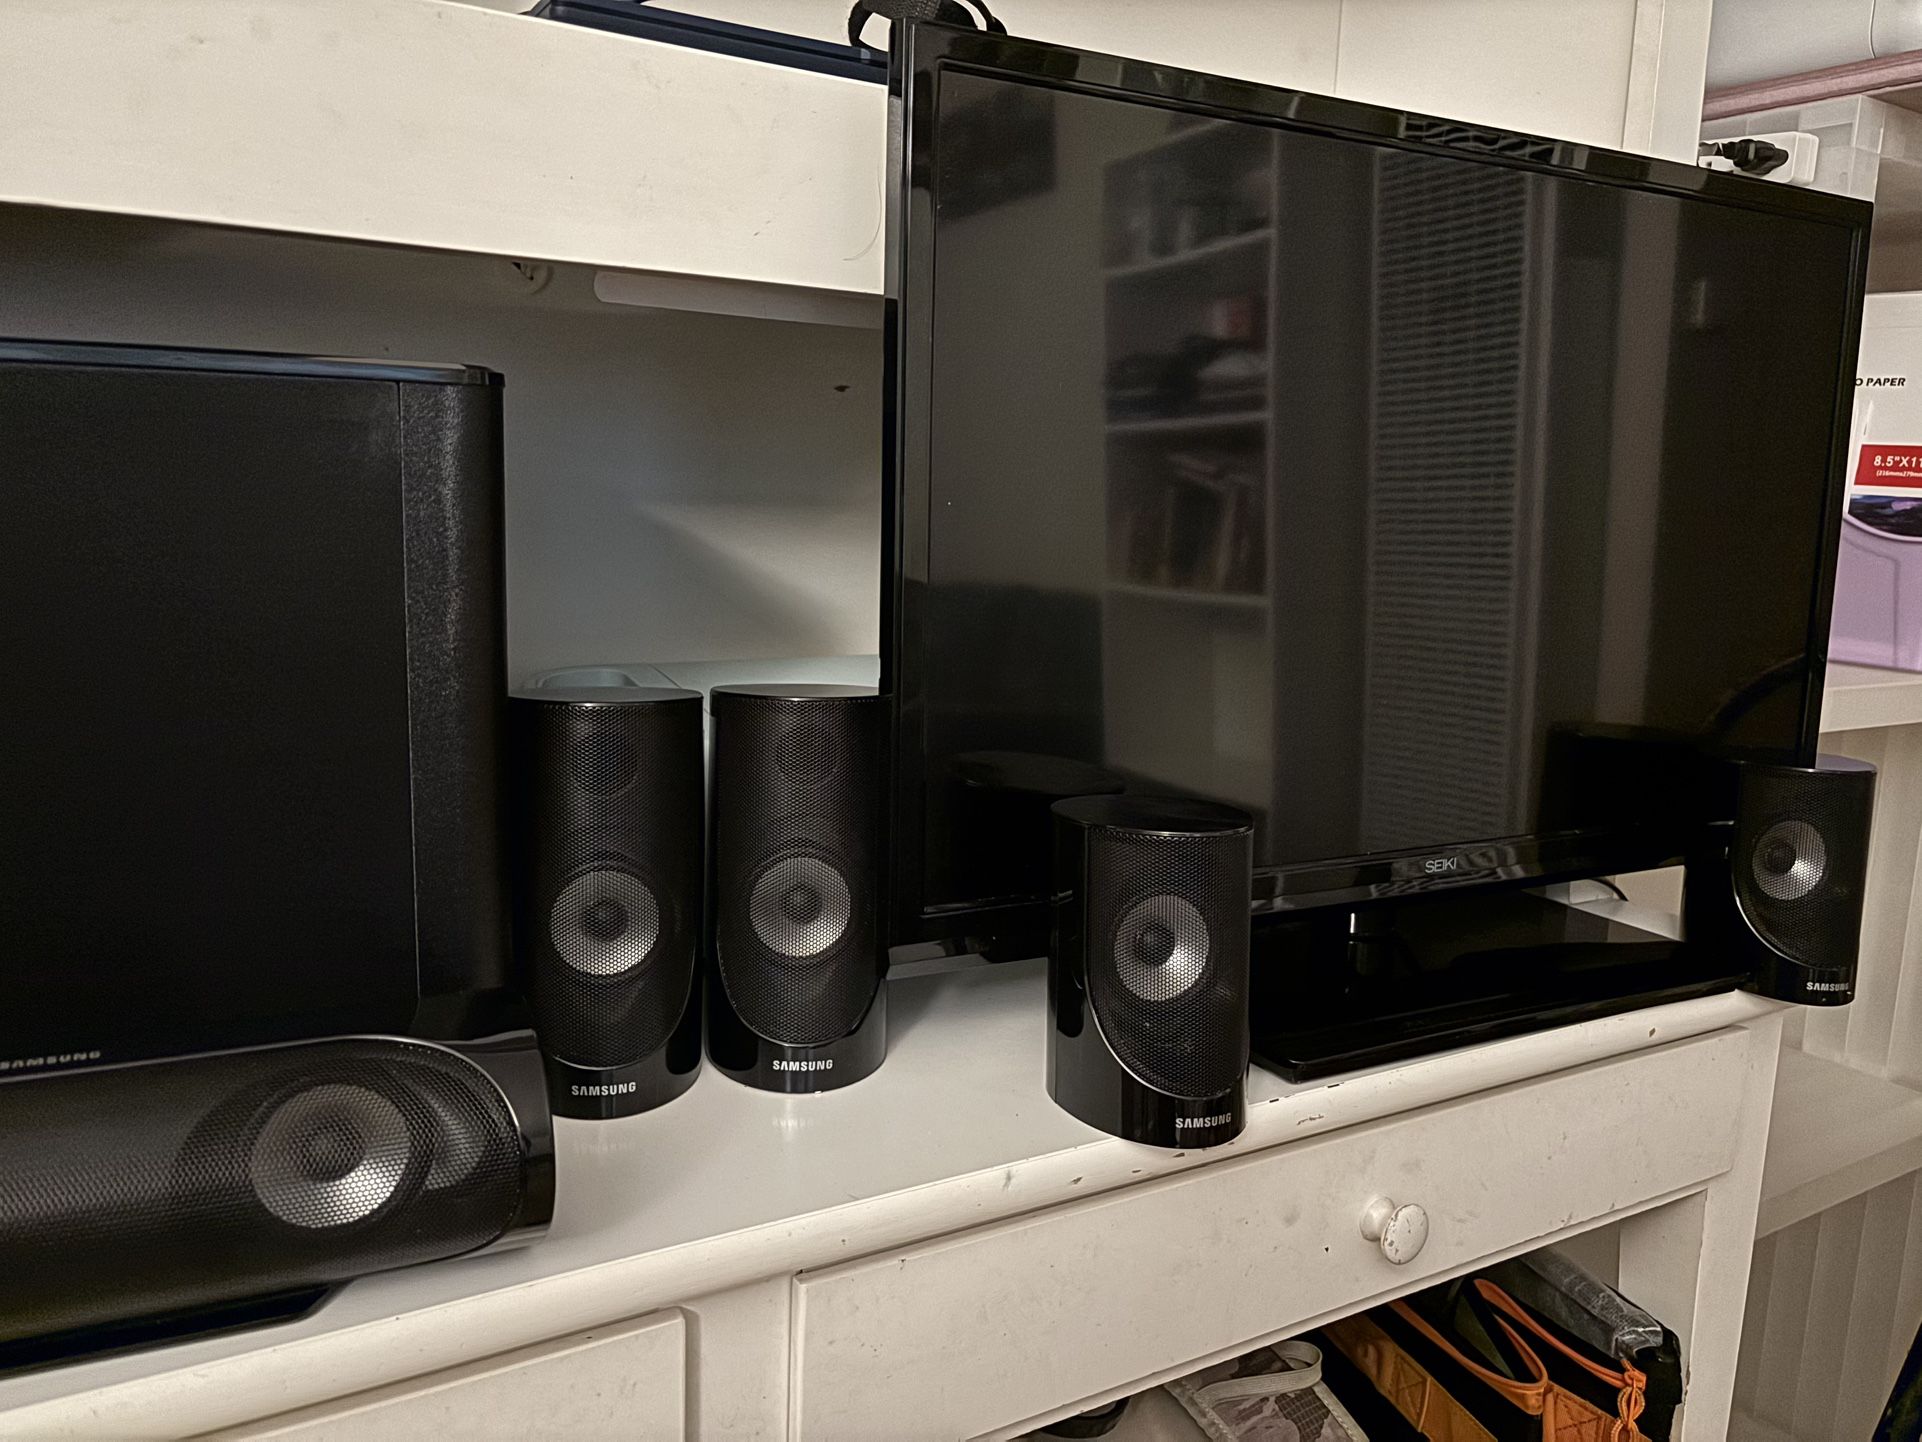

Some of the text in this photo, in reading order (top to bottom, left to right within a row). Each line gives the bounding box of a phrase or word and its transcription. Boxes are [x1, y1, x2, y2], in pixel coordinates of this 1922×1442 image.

[1866, 377, 1906, 387] PAPER
[1425, 857, 1457, 873] SEIKI
[1806, 981, 1849, 992] SAMSUNG
[772, 1059, 834, 1072] SAMSUNG
[571, 1081, 637, 1097] SAMSUNG
[1175, 1112, 1232, 1129] SAMSUNG
